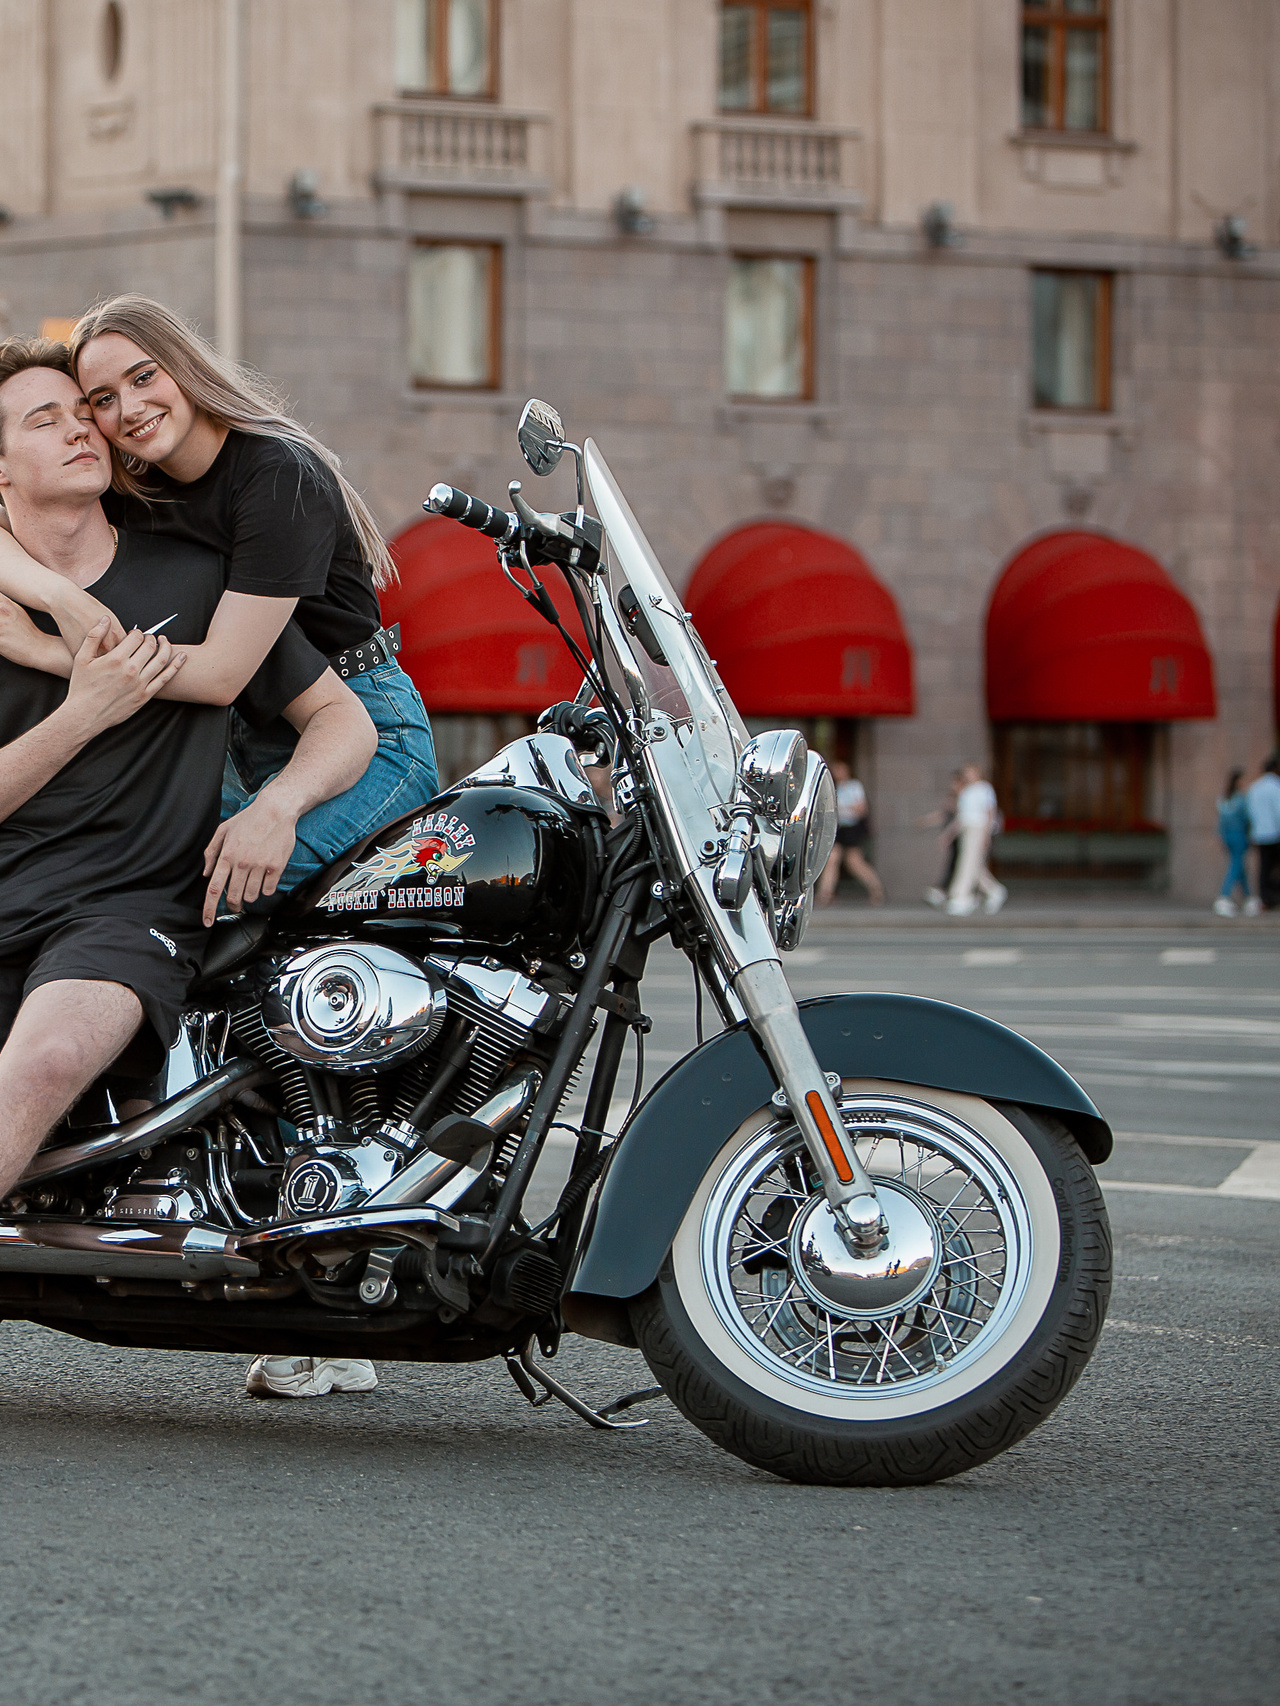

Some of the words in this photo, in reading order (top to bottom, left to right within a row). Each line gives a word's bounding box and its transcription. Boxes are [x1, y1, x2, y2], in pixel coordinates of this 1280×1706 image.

[412, 813, 476, 850] HARLEY
[387, 886, 465, 909] DAVIDSON
[149, 928, 177, 957] adidas
[1053, 1177, 1071, 1212] Conti
[1059, 1217, 1074, 1283] Milestone
